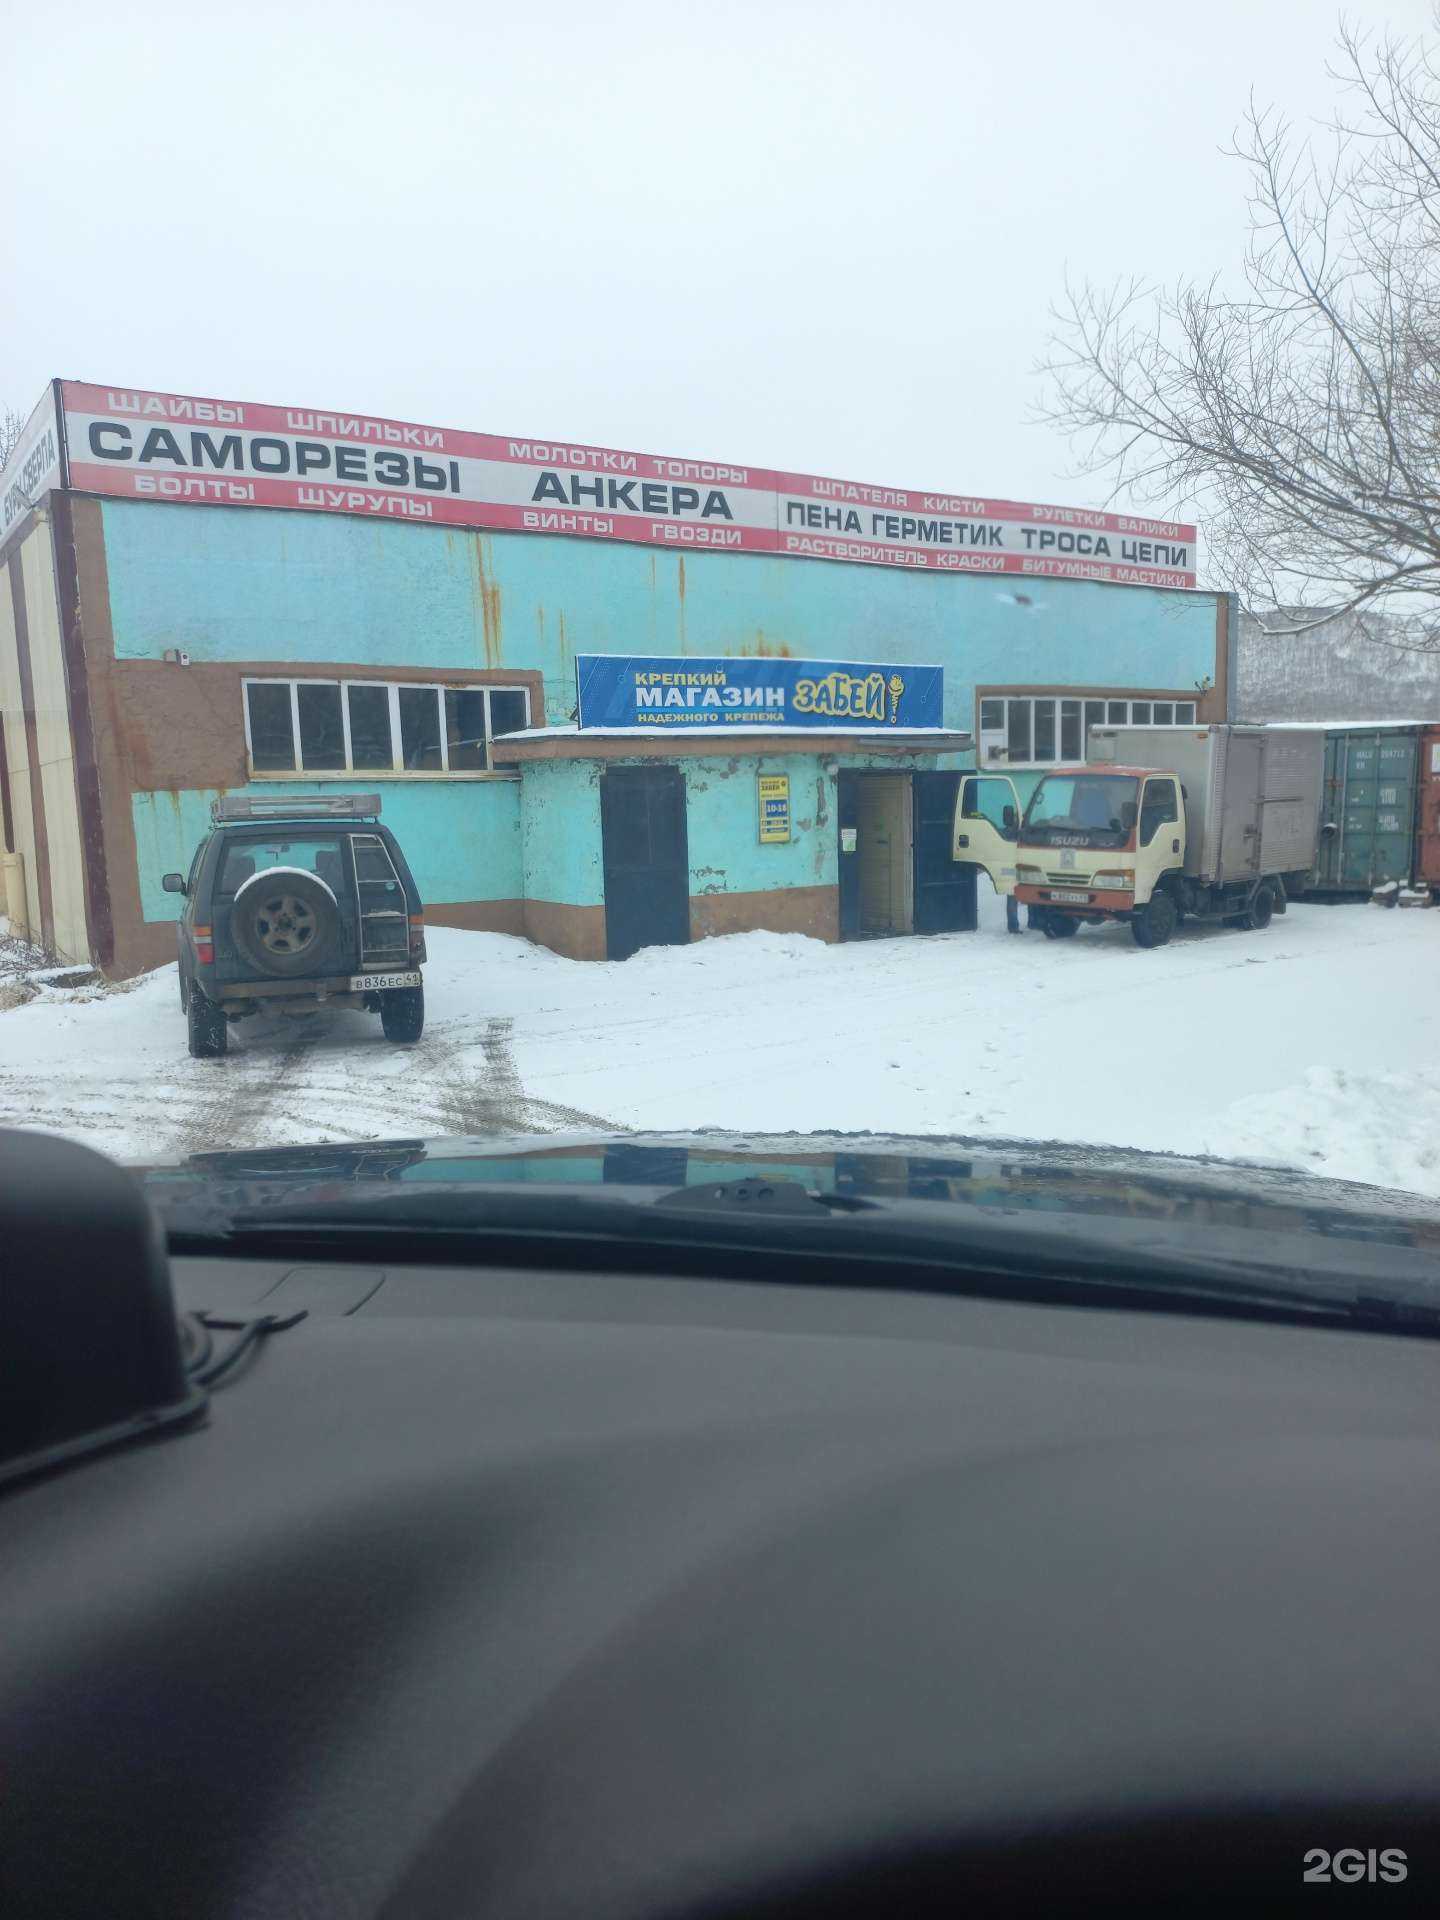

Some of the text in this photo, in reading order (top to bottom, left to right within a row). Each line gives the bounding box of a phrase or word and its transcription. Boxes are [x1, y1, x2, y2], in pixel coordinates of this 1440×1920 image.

[106, 392, 1179, 538] ШАЙБЫ ШПИЛЬКИ МОЛОТКИ ТОПОРЫ ШПАТЕЛЯ КИСТИ РУЛЕТКИ ВАЛИКИ
[88, 421, 1187, 568] САМОРЕЗЫ АНКЕРА ПЕНА ГЕРМЕТИК ТРОСА ЦЕПИ
[133, 474, 1187, 587] БОЛТЫ ШУРУПЫ ВИНТЫ ГВОЗДИ РАСТВОРИТЕЛЬ КРАСКИ БИТУМНЫЕ МАСТИКИ
[635, 672, 727, 686] КРЕПКИЙ
[635, 687, 785, 707] МАГАЗИН
[638, 712, 785, 723] НАДЕЖНОГО КРЕПЕЖА
[1050, 836, 1090, 846] ISUZU
